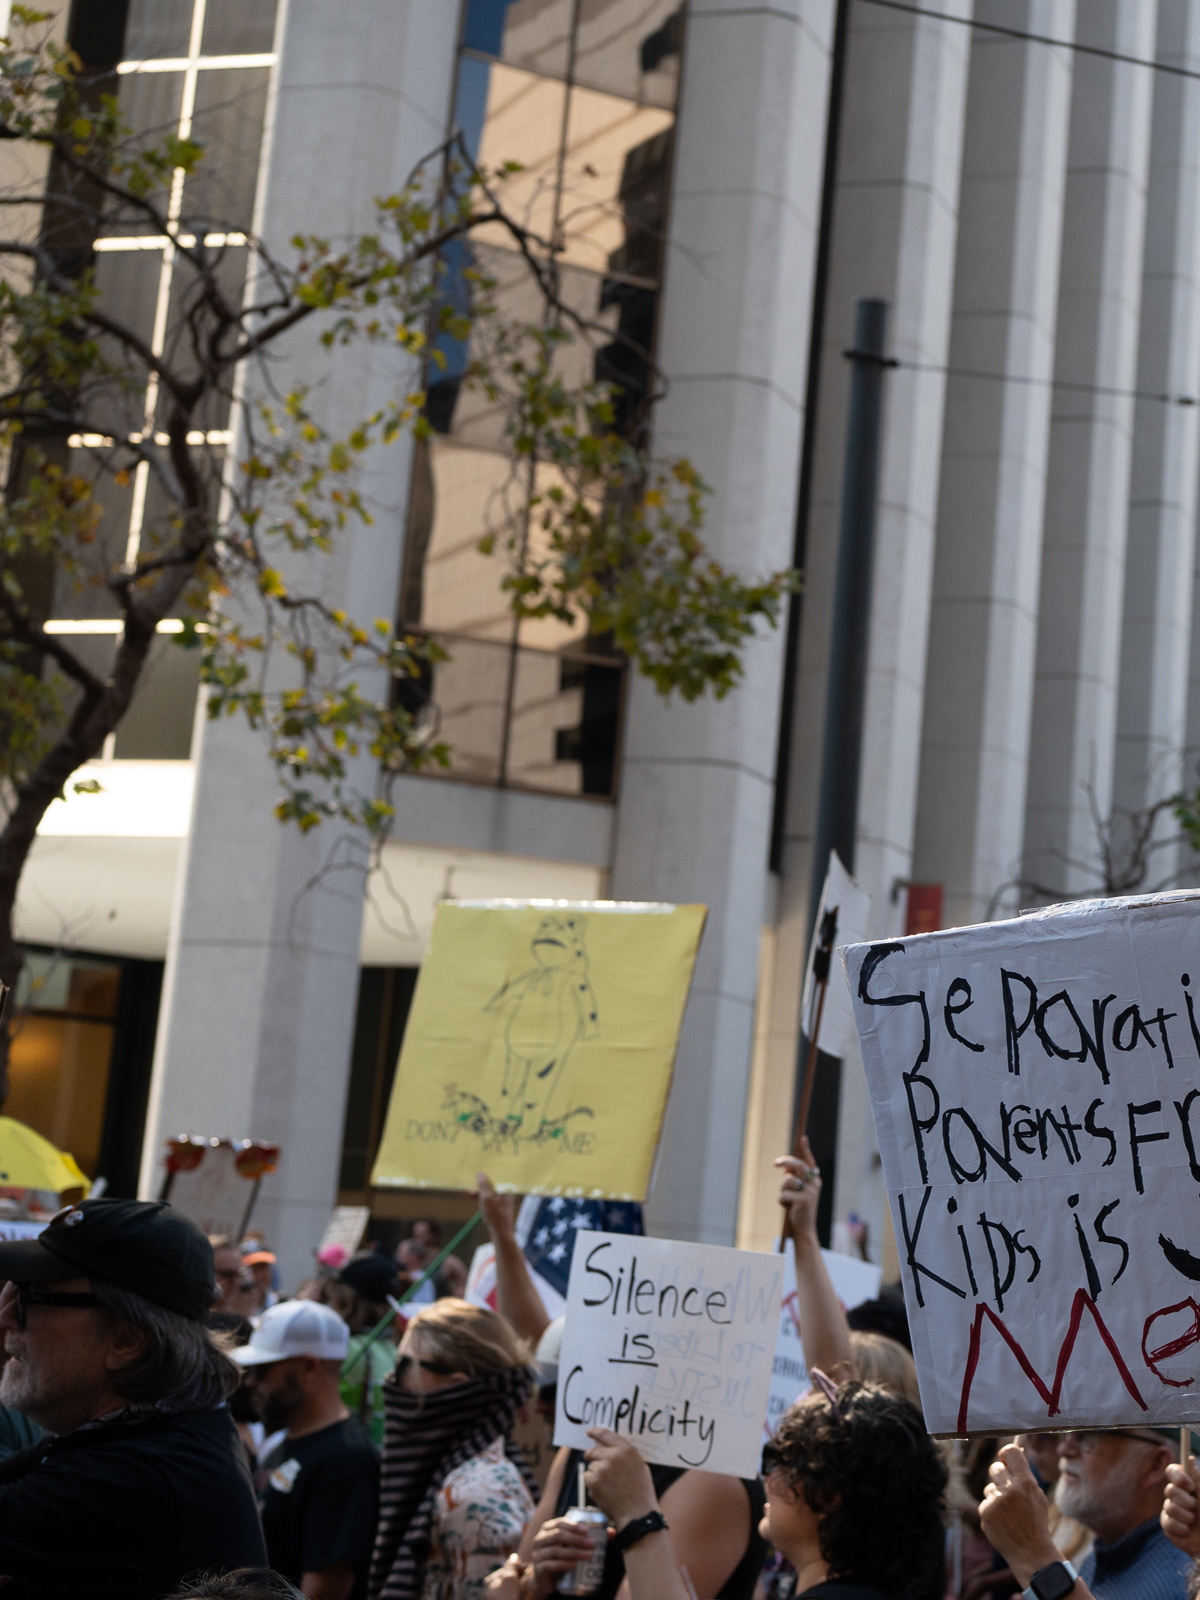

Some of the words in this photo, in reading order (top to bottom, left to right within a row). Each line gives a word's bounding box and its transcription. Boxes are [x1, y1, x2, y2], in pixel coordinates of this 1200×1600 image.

[583, 1241, 733, 1325] Silence
[621, 1327, 656, 1360] is
[562, 1365, 716, 1467] Complicity
